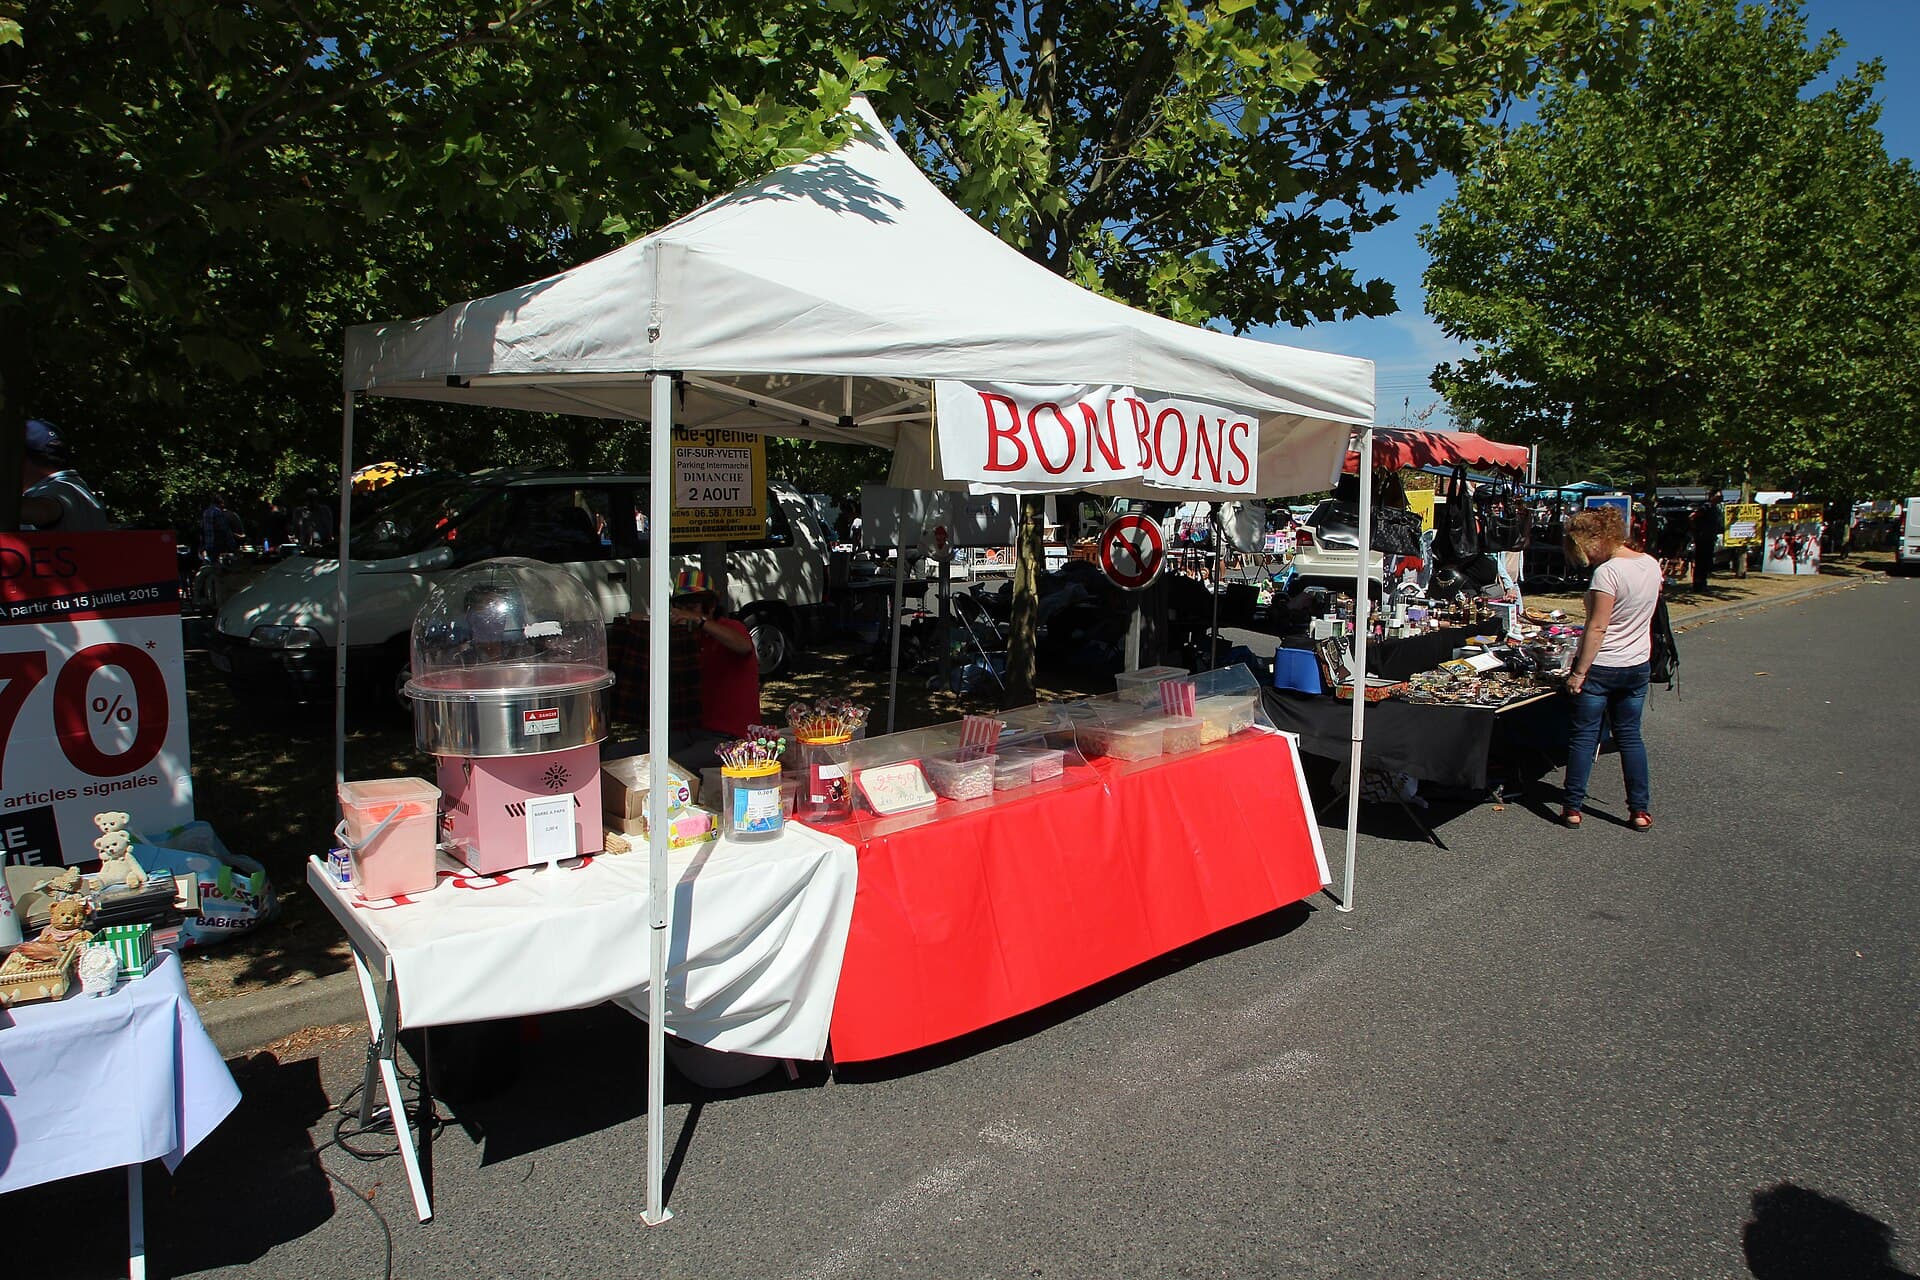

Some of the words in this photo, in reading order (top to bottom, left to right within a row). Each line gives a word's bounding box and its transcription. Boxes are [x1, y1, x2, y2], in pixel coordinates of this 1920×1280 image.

[977, 391, 1250, 486] BONBONS
[676, 448, 749, 458] GIF-SUR-YVETTE
[677, 461, 705, 470] Parking
[683, 472, 744, 482] DIMANCHE
[688, 488, 698, 501] 2
[702, 487, 740, 501] AOUT
[11, 602, 48, 618] partir
[52, 600, 70, 610] du
[73, 597, 89, 607] 15
[91, 593, 126, 608] juillet
[129, 588, 159, 600] 2015
[4, 789, 78, 808] articles
[82, 775, 158, 797] signalés
